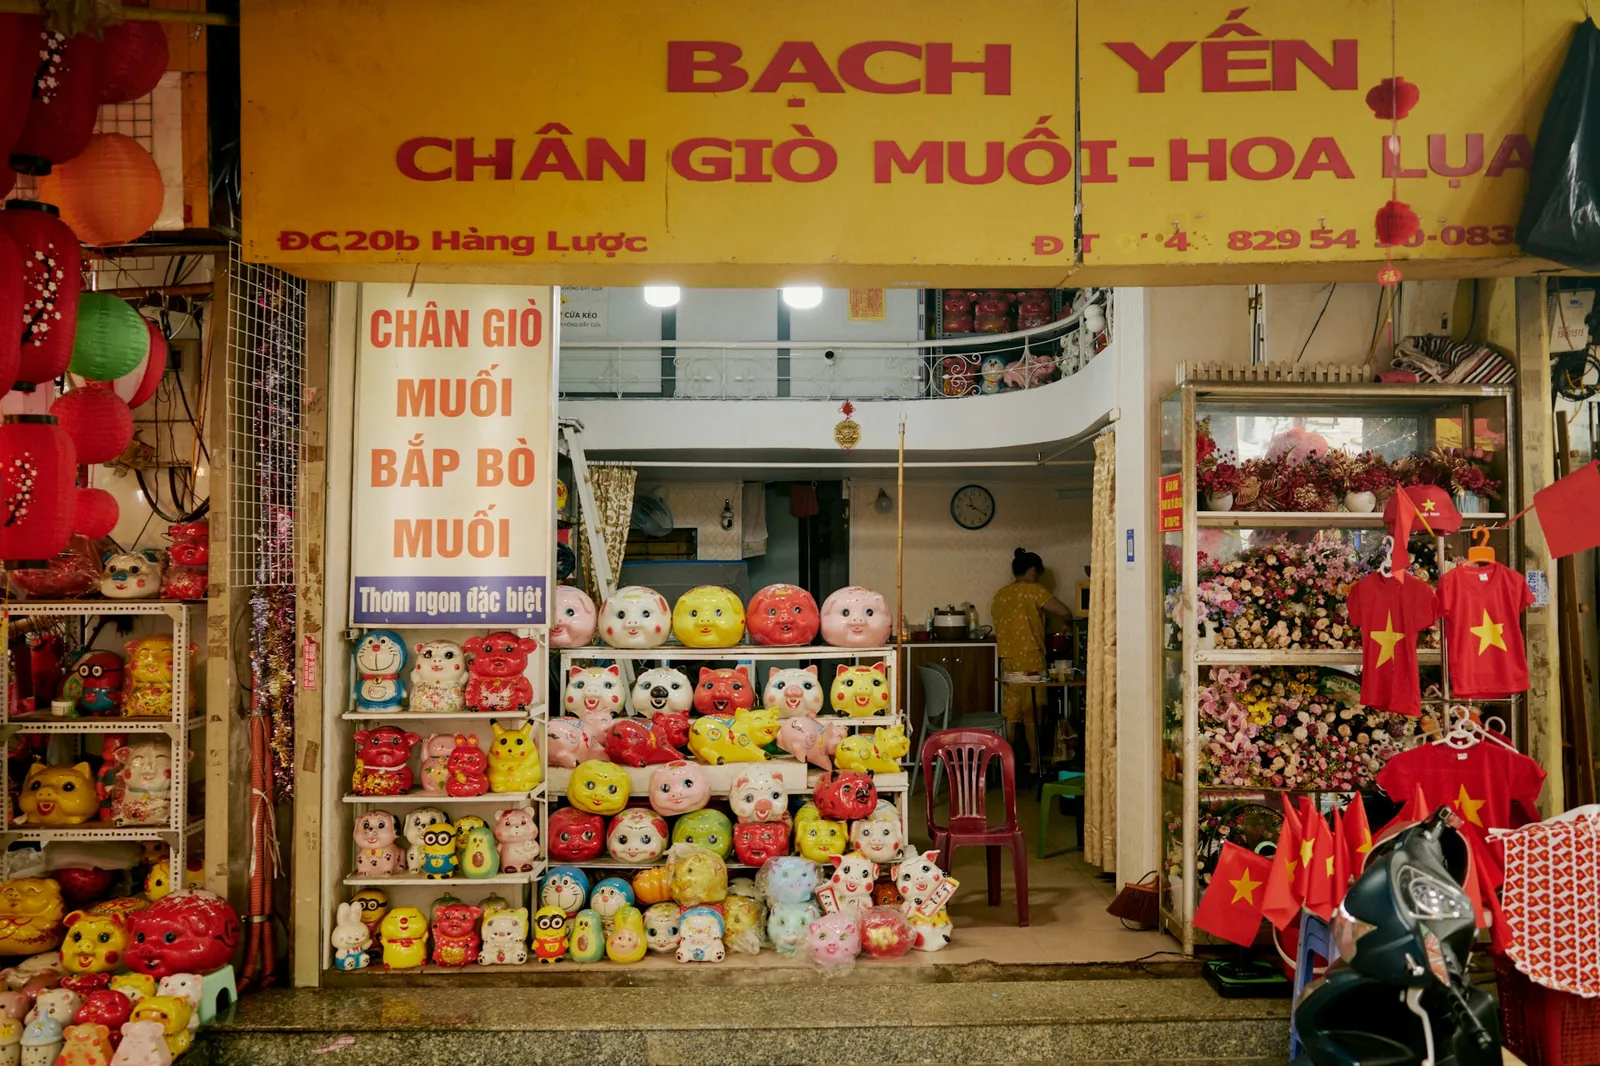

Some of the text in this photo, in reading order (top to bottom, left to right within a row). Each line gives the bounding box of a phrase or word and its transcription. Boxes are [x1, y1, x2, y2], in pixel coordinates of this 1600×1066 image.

[667, 7, 1358, 107] BẠCH YẾN
[396, 123, 646, 182] CHÂN
[671, 124, 838, 183] GIÒ
[1382, 134, 1533, 188] LỤA
[432, 227, 535, 256] Hàng
[547, 231, 648, 258] Lược
[1228, 229, 1300, 251] 829
[1310, 228, 1360, 249] 54
[370, 298, 542, 349] CHÂN GIÒ
[396, 364, 513, 418] MUỐI
[371, 433, 535, 488] BẮP BÒ
[393, 504, 510, 559] MUỐI
[360, 585, 543, 619] Thơm ngon đặc biệt
